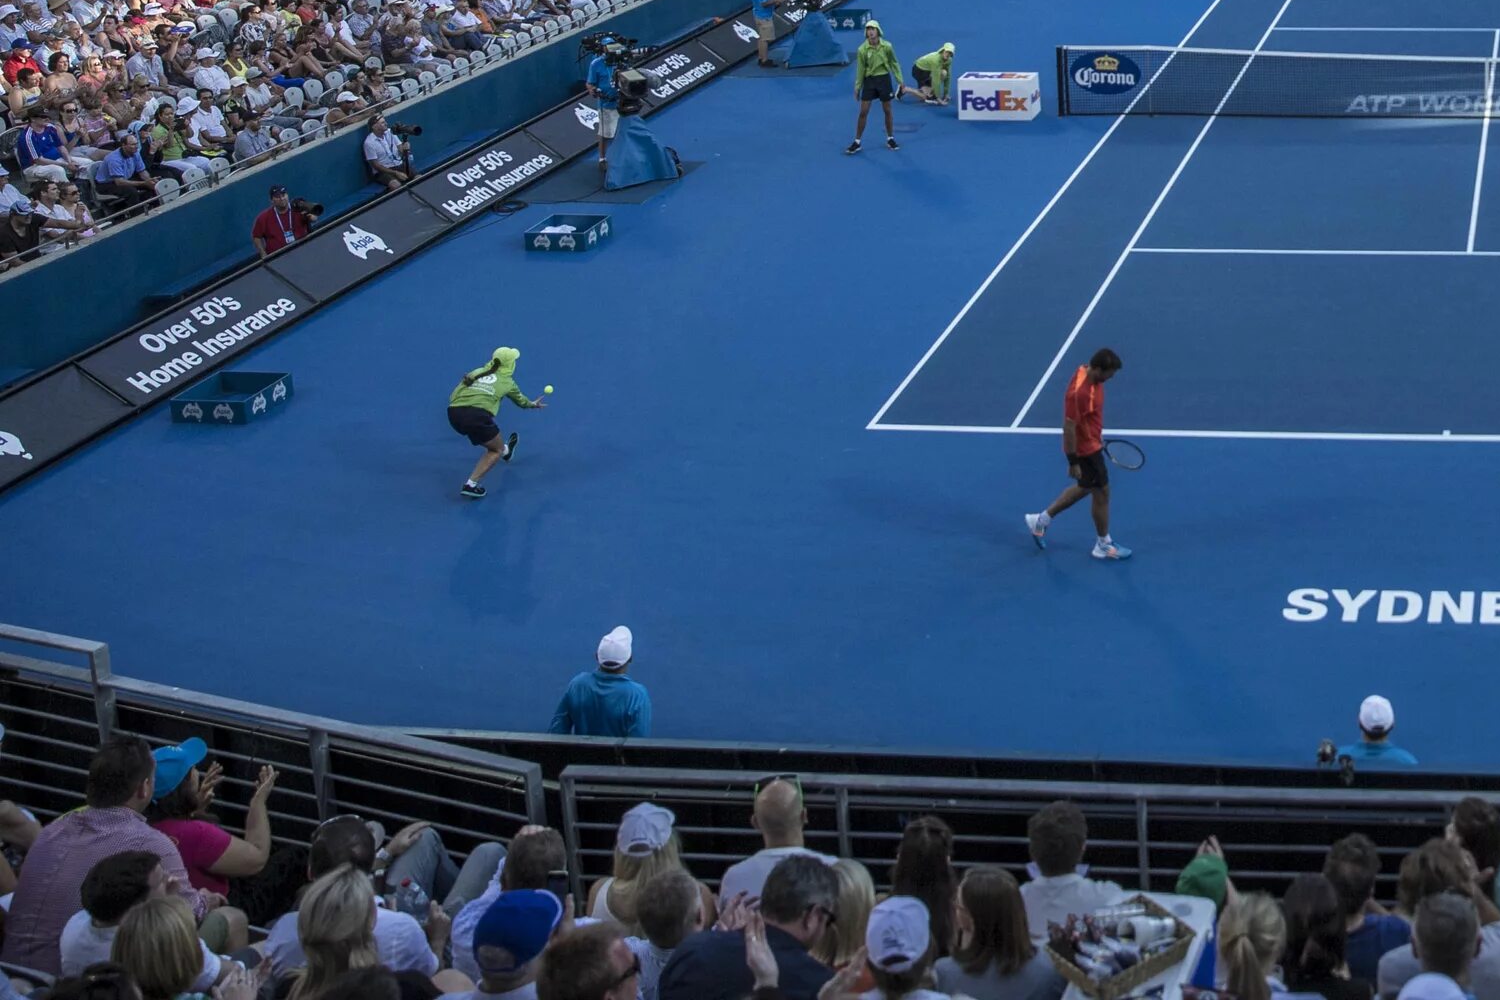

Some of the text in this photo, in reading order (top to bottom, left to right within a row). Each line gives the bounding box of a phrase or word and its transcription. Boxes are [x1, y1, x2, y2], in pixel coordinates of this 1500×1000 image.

[666, 52, 691, 70] 50's
[650, 60, 716, 99] Car Insurance
[1075, 66, 1135, 88] Corona
[961, 90, 1028, 111] FedEx
[1345, 95, 1406, 113] ATP
[447, 150, 513, 188] Over 50's
[442, 152, 553, 217] Health Insurance
[350, 234, 375, 251] Apia
[139, 296, 242, 353] Over 50's
[126, 298, 297, 394] Home Insurance
